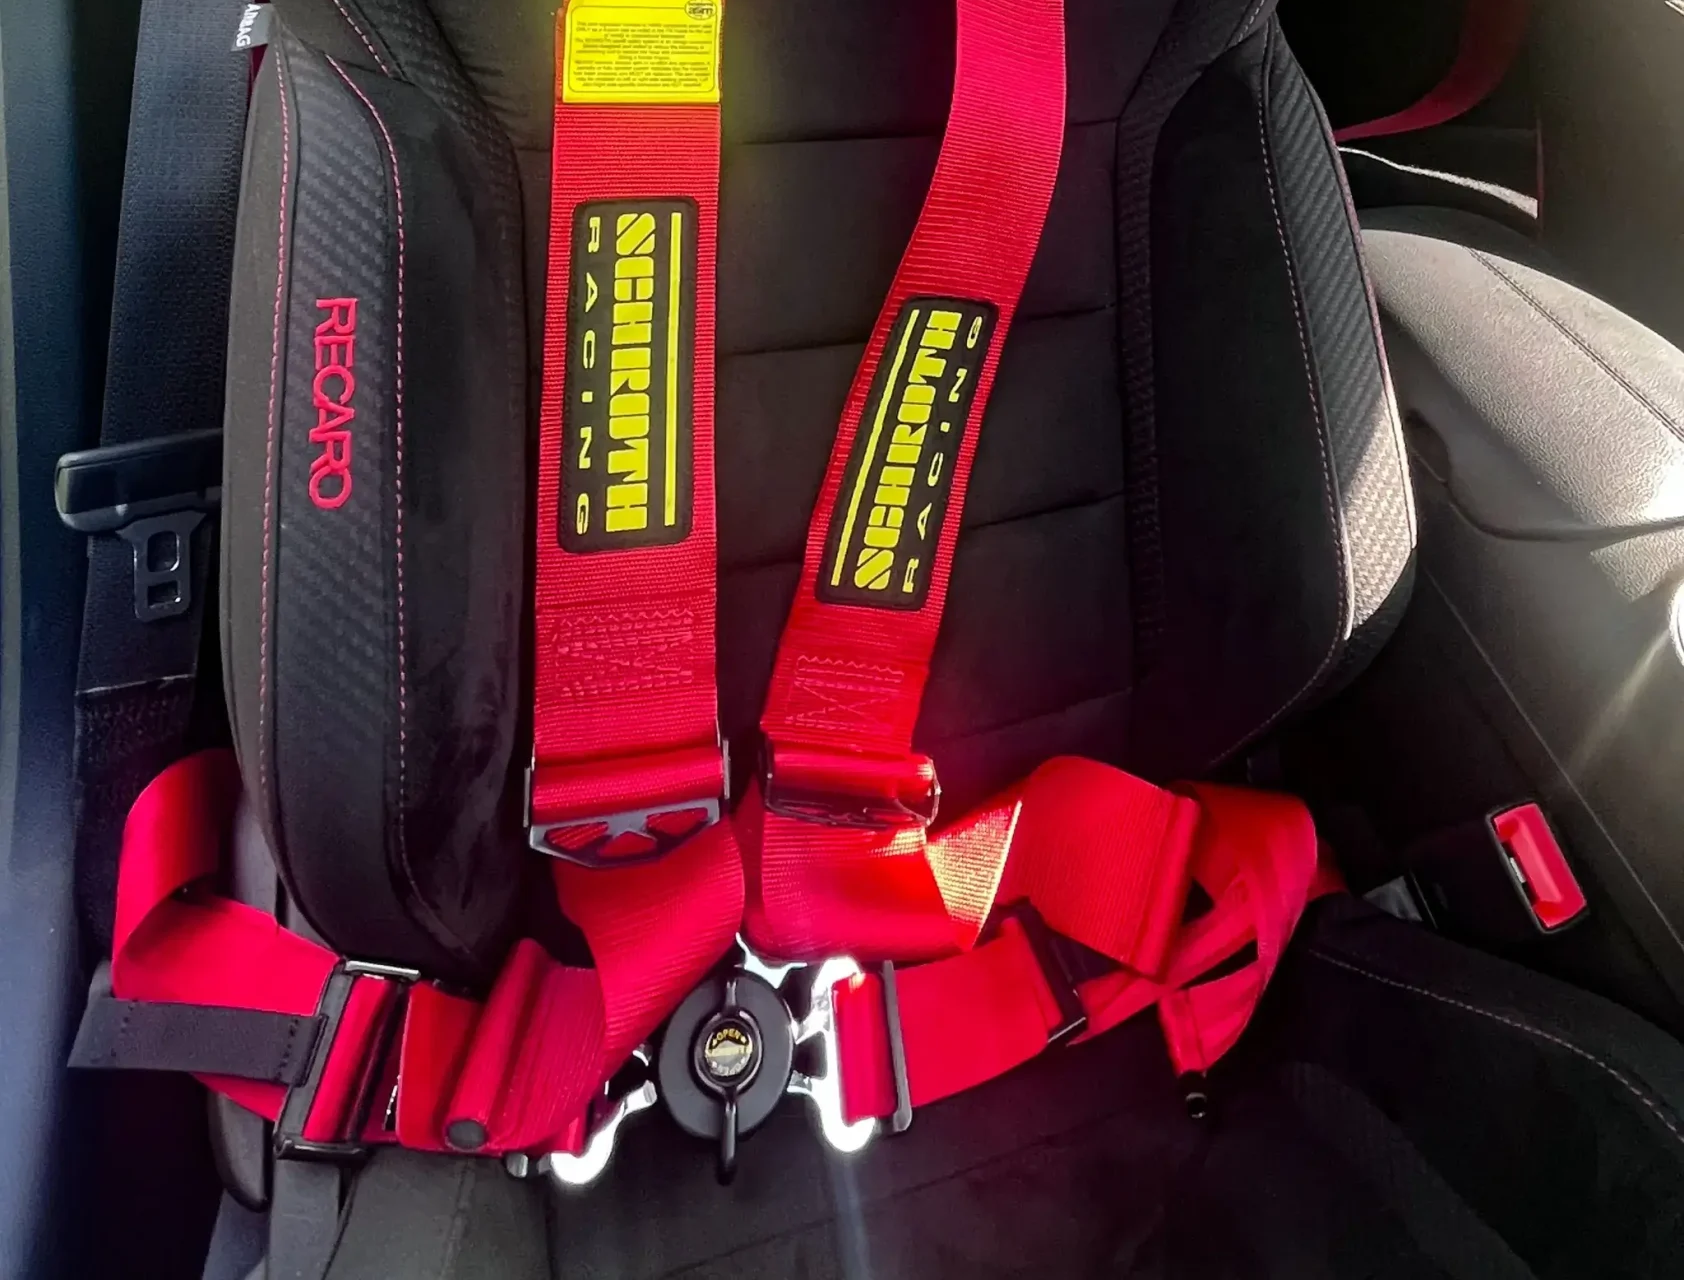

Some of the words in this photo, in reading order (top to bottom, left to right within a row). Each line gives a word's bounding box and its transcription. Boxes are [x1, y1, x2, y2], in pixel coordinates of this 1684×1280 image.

[309, 297, 359, 510] RECARO
[576, 216, 601, 535] RACING
[606, 212, 656, 532] SCHROTH
[854, 310, 963, 590] SCHROTH
[902, 316, 983, 593] RACING
[716, 1028, 742, 1041] OPEN
